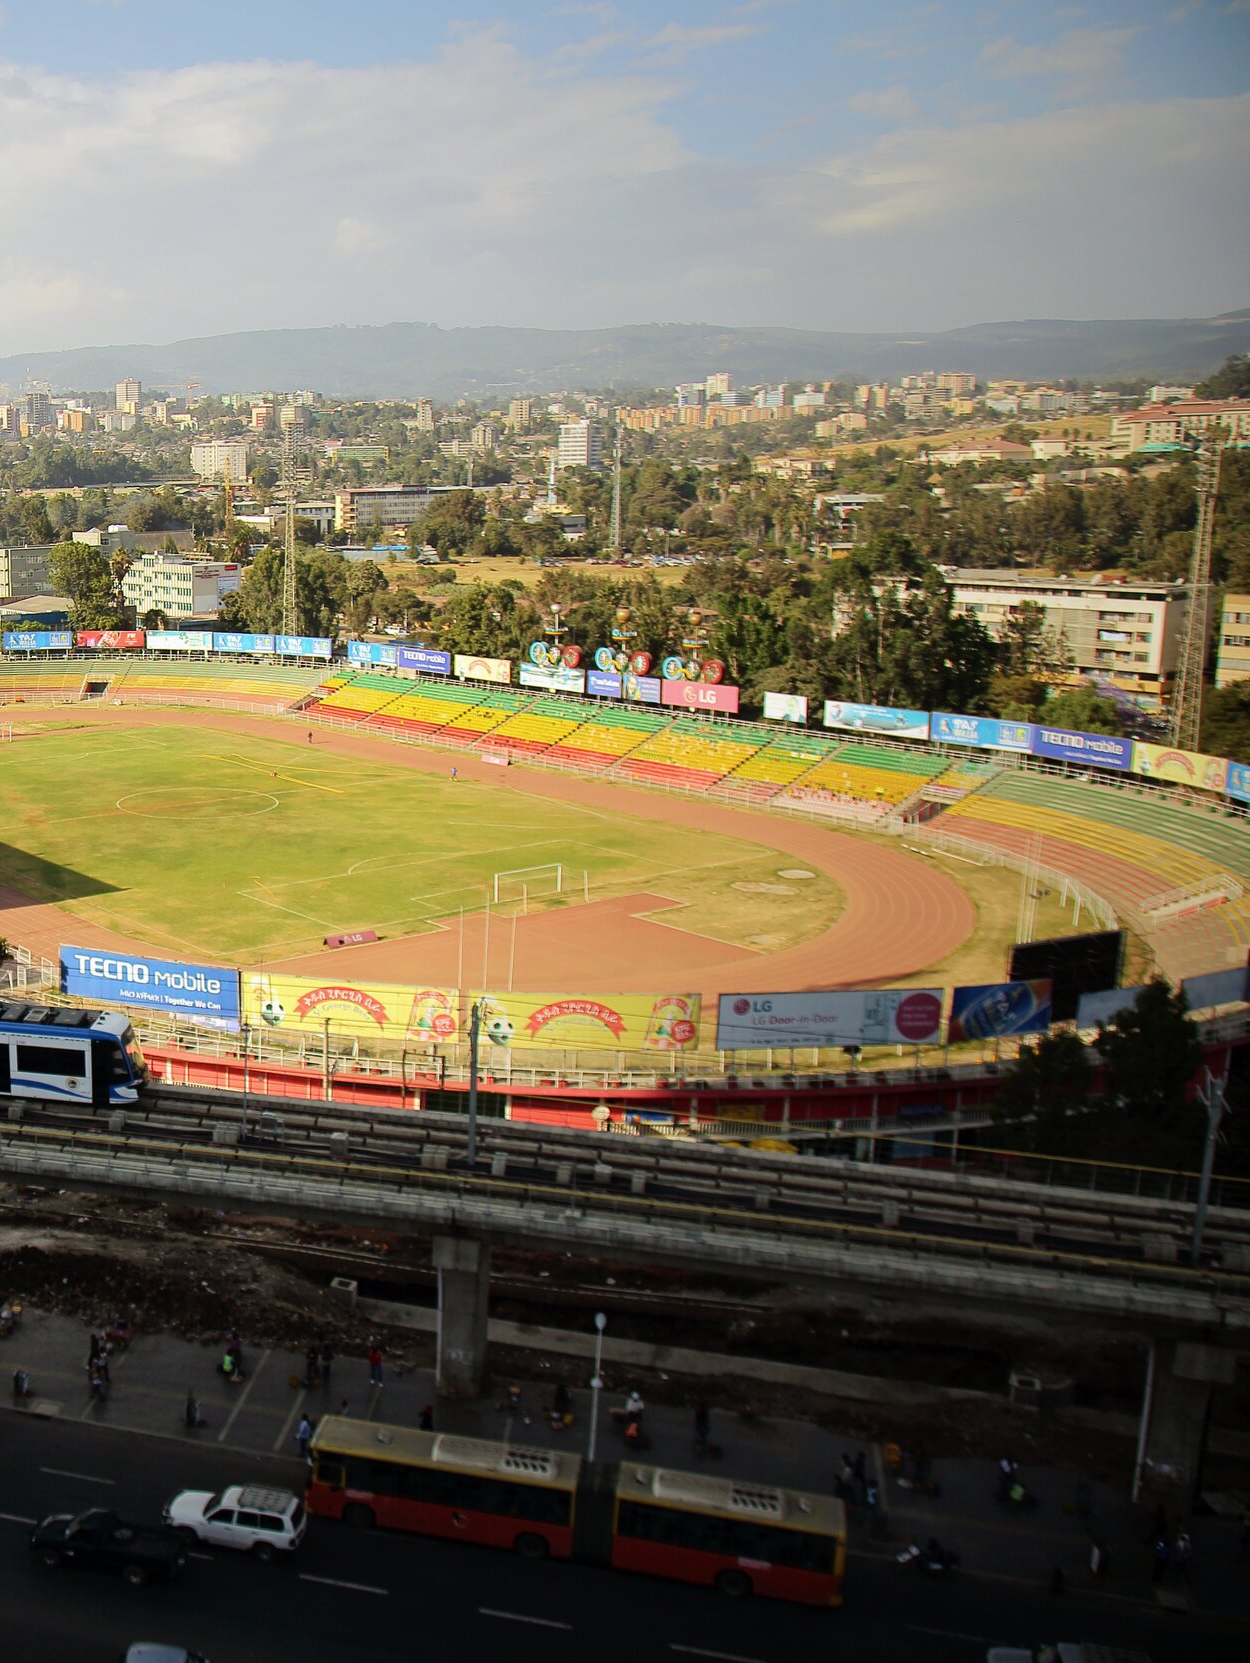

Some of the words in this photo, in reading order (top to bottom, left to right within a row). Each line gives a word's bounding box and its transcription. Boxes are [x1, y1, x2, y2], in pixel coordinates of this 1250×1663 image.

[403, 650, 426, 661] TECNO
[698, 689, 717, 704] LG
[1039, 730, 1085, 749] TECNO
[351, 934, 363, 942] LG
[74, 954, 150, 984] TECNO
[164, 996, 194, 1007] Together
[194, 1000, 207, 1009] We
[207, 1001, 221, 1010] Can
[753, 1000, 773, 1013] LG
[753, 1016, 767, 1026] LG
